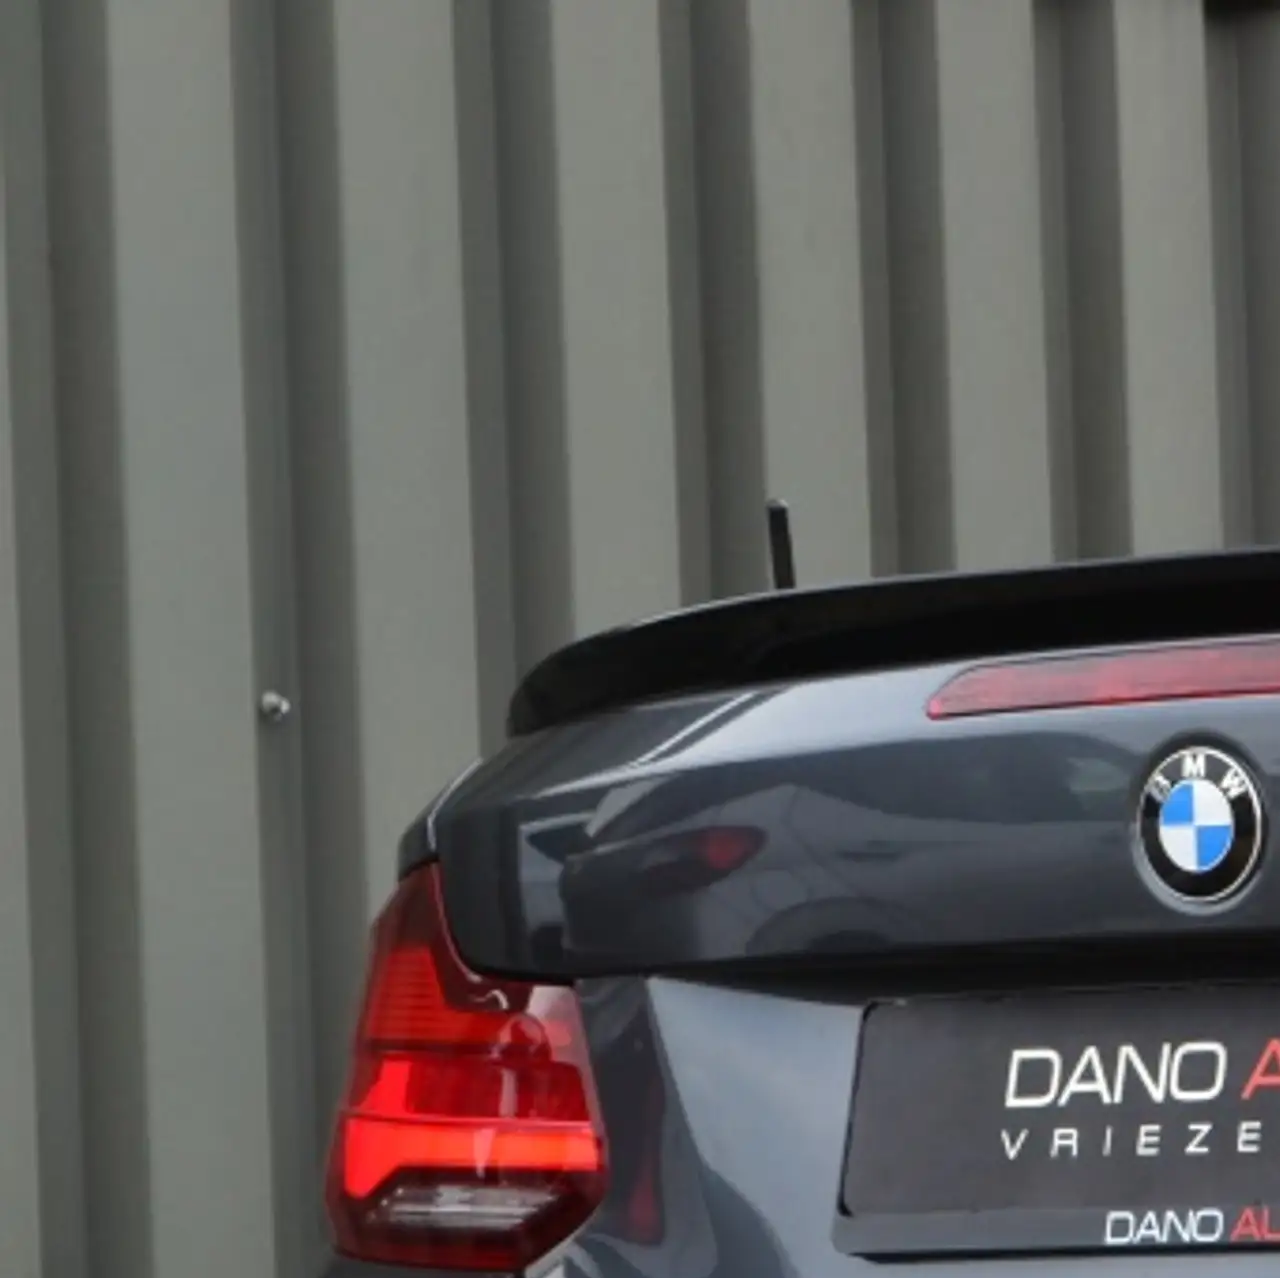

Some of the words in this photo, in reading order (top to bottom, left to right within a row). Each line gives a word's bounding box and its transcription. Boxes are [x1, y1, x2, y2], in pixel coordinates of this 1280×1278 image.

[1147, 752, 1249, 803] BMW
[1004, 1041, 1228, 1109] DANO
[1104, 1207, 1225, 1245] DANO
